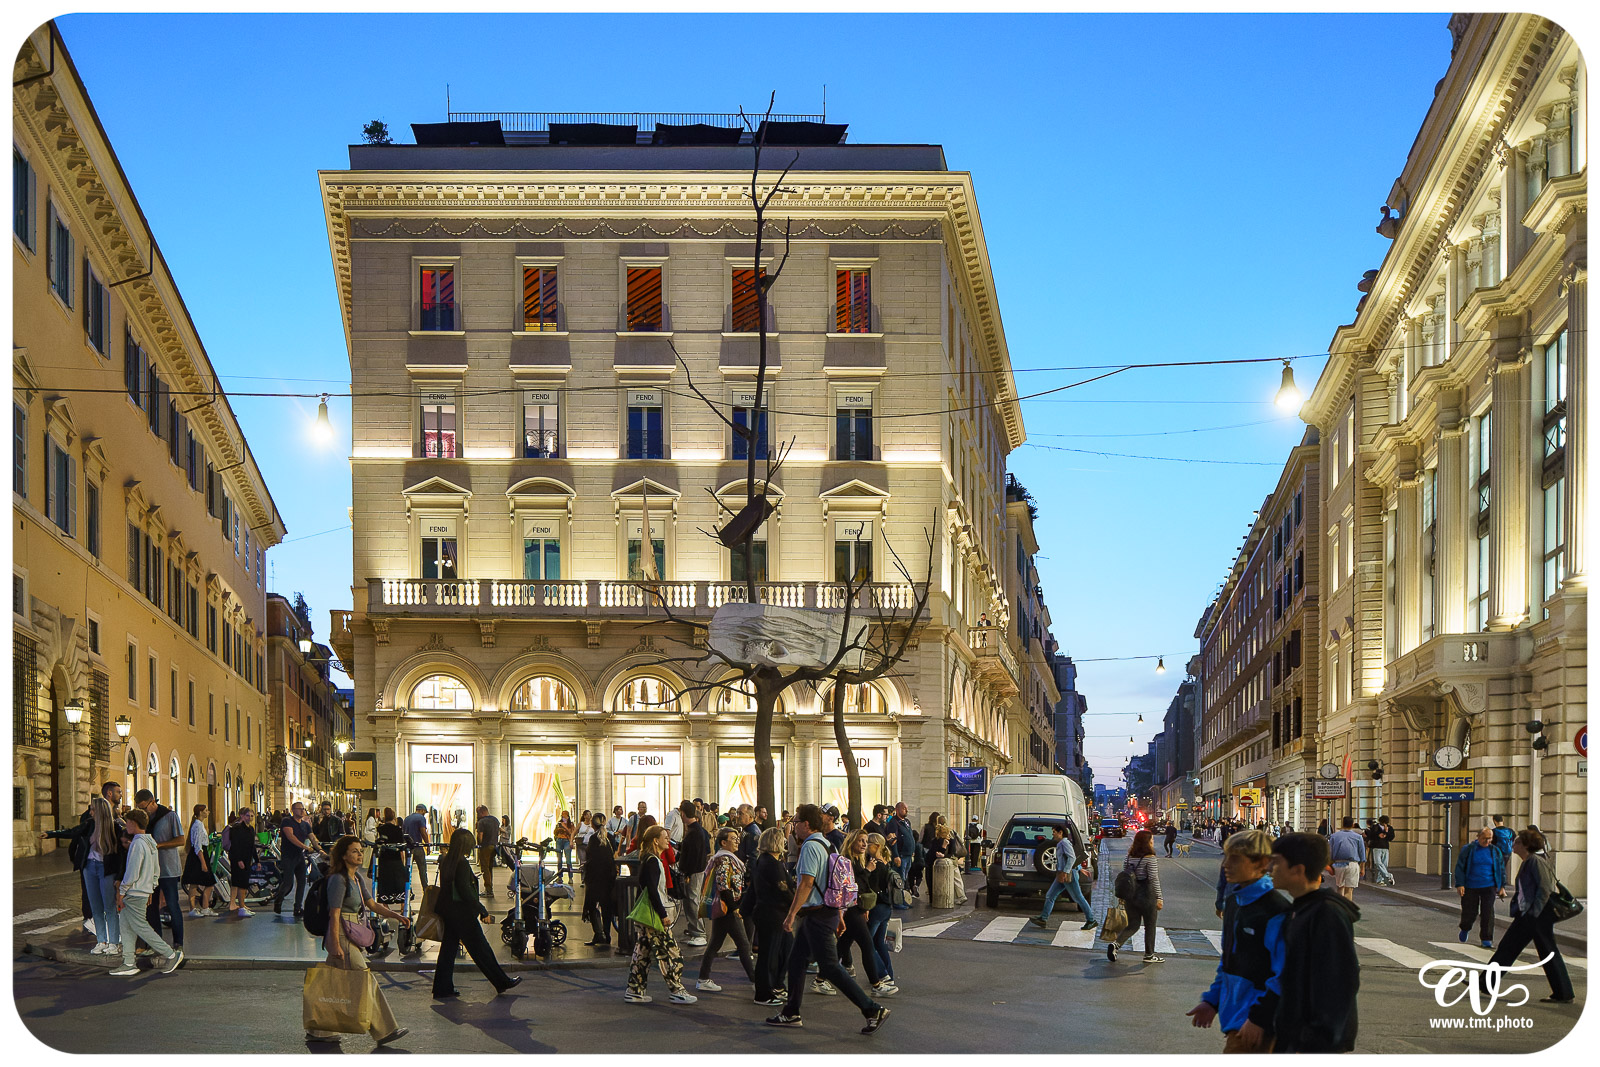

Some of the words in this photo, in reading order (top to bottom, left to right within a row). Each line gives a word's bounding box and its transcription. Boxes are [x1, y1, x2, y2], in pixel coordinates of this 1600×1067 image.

[426, 754, 458, 763] FENDI
[631, 756, 664, 765] FENDI
[837, 758, 870, 767] FDI
